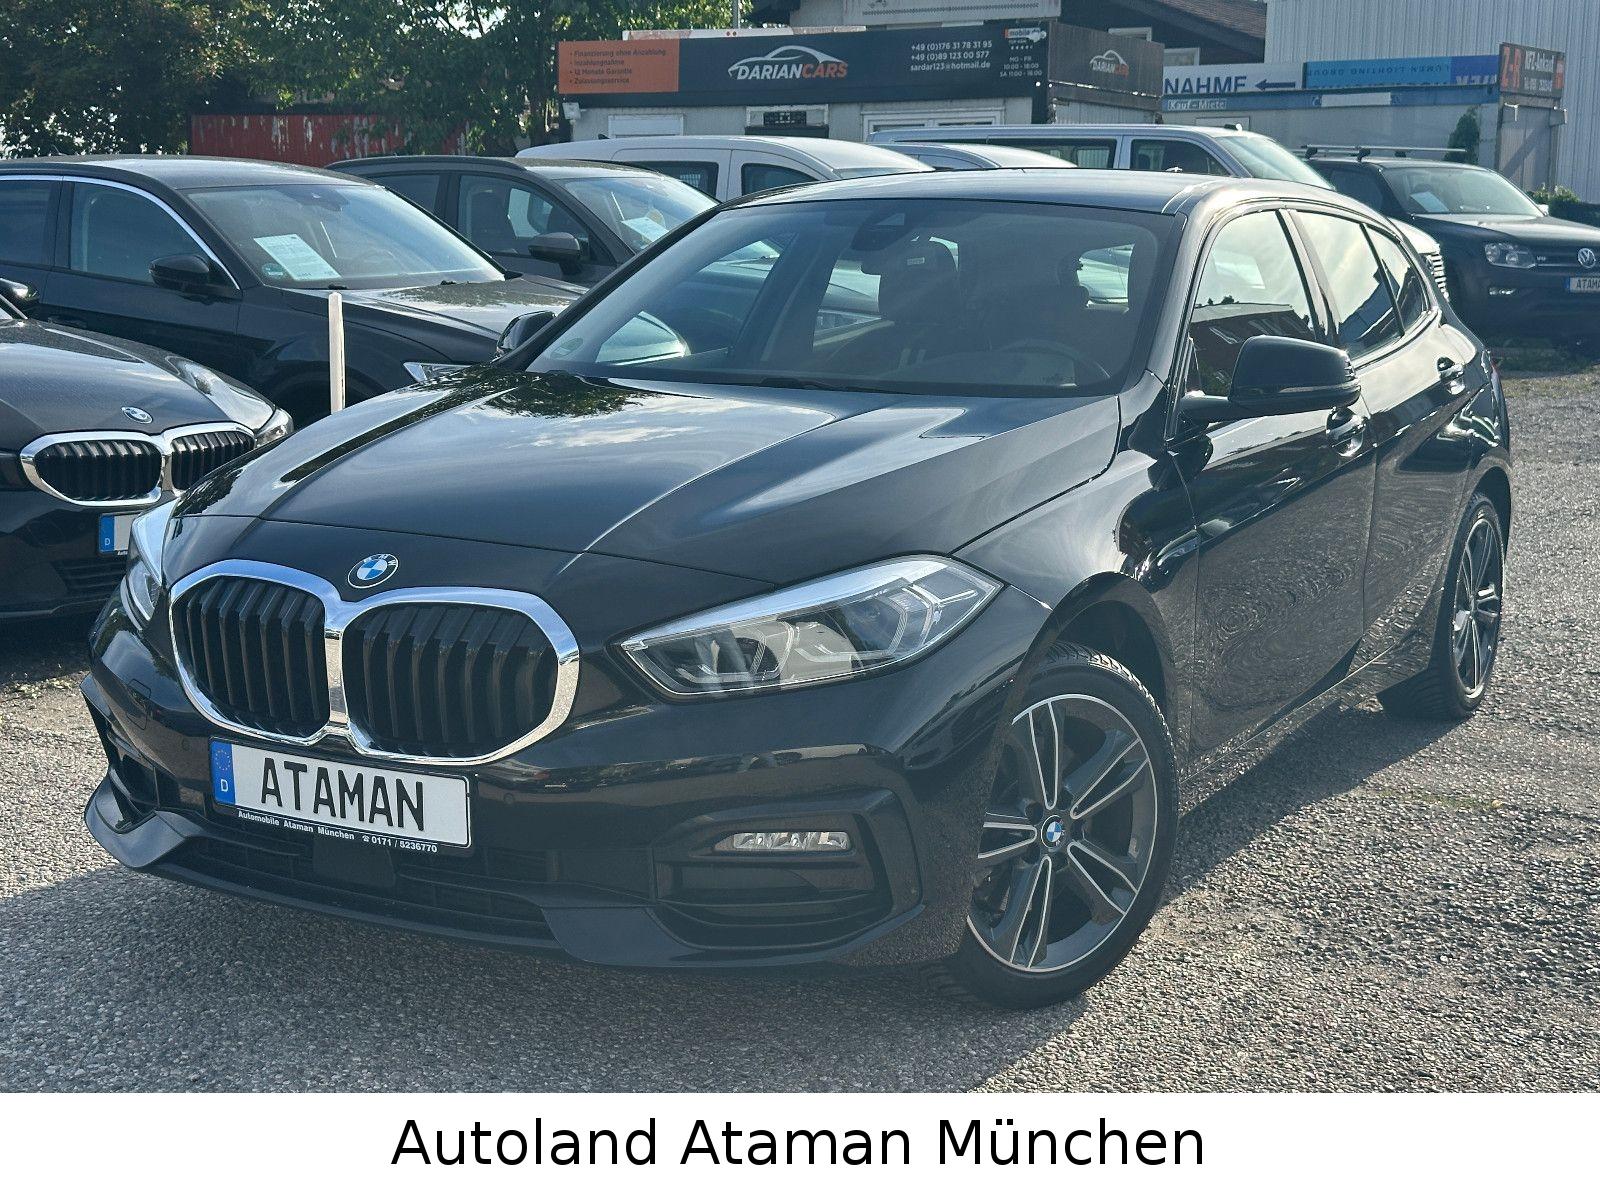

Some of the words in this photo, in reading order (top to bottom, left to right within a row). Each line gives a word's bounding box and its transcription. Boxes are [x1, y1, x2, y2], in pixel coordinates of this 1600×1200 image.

[911, 43, 926, 51] +49
[952, 41, 961, 50] 31
[962, 41, 971, 49] 78
[973, 41, 981, 49] 31
[983, 40, 993, 49] 95
[911, 53, 926, 61] +49
[927, 52, 948, 60] (0)89
[963, 51, 974, 59] 00
[736, 63, 849, 80] DARIANCARS
[910, 61, 991, 71] sardar123@hotmail.de
[220, 779, 229, 792] D
[260, 757, 424, 832] ATAMAN
[238, 811, 280, 826] Automobile
[283, 820, 314, 833] Ataman
[317, 827, 355, 840] München
[371, 836, 392, 847] 0171
[399, 840, 438, 853] 5236770
